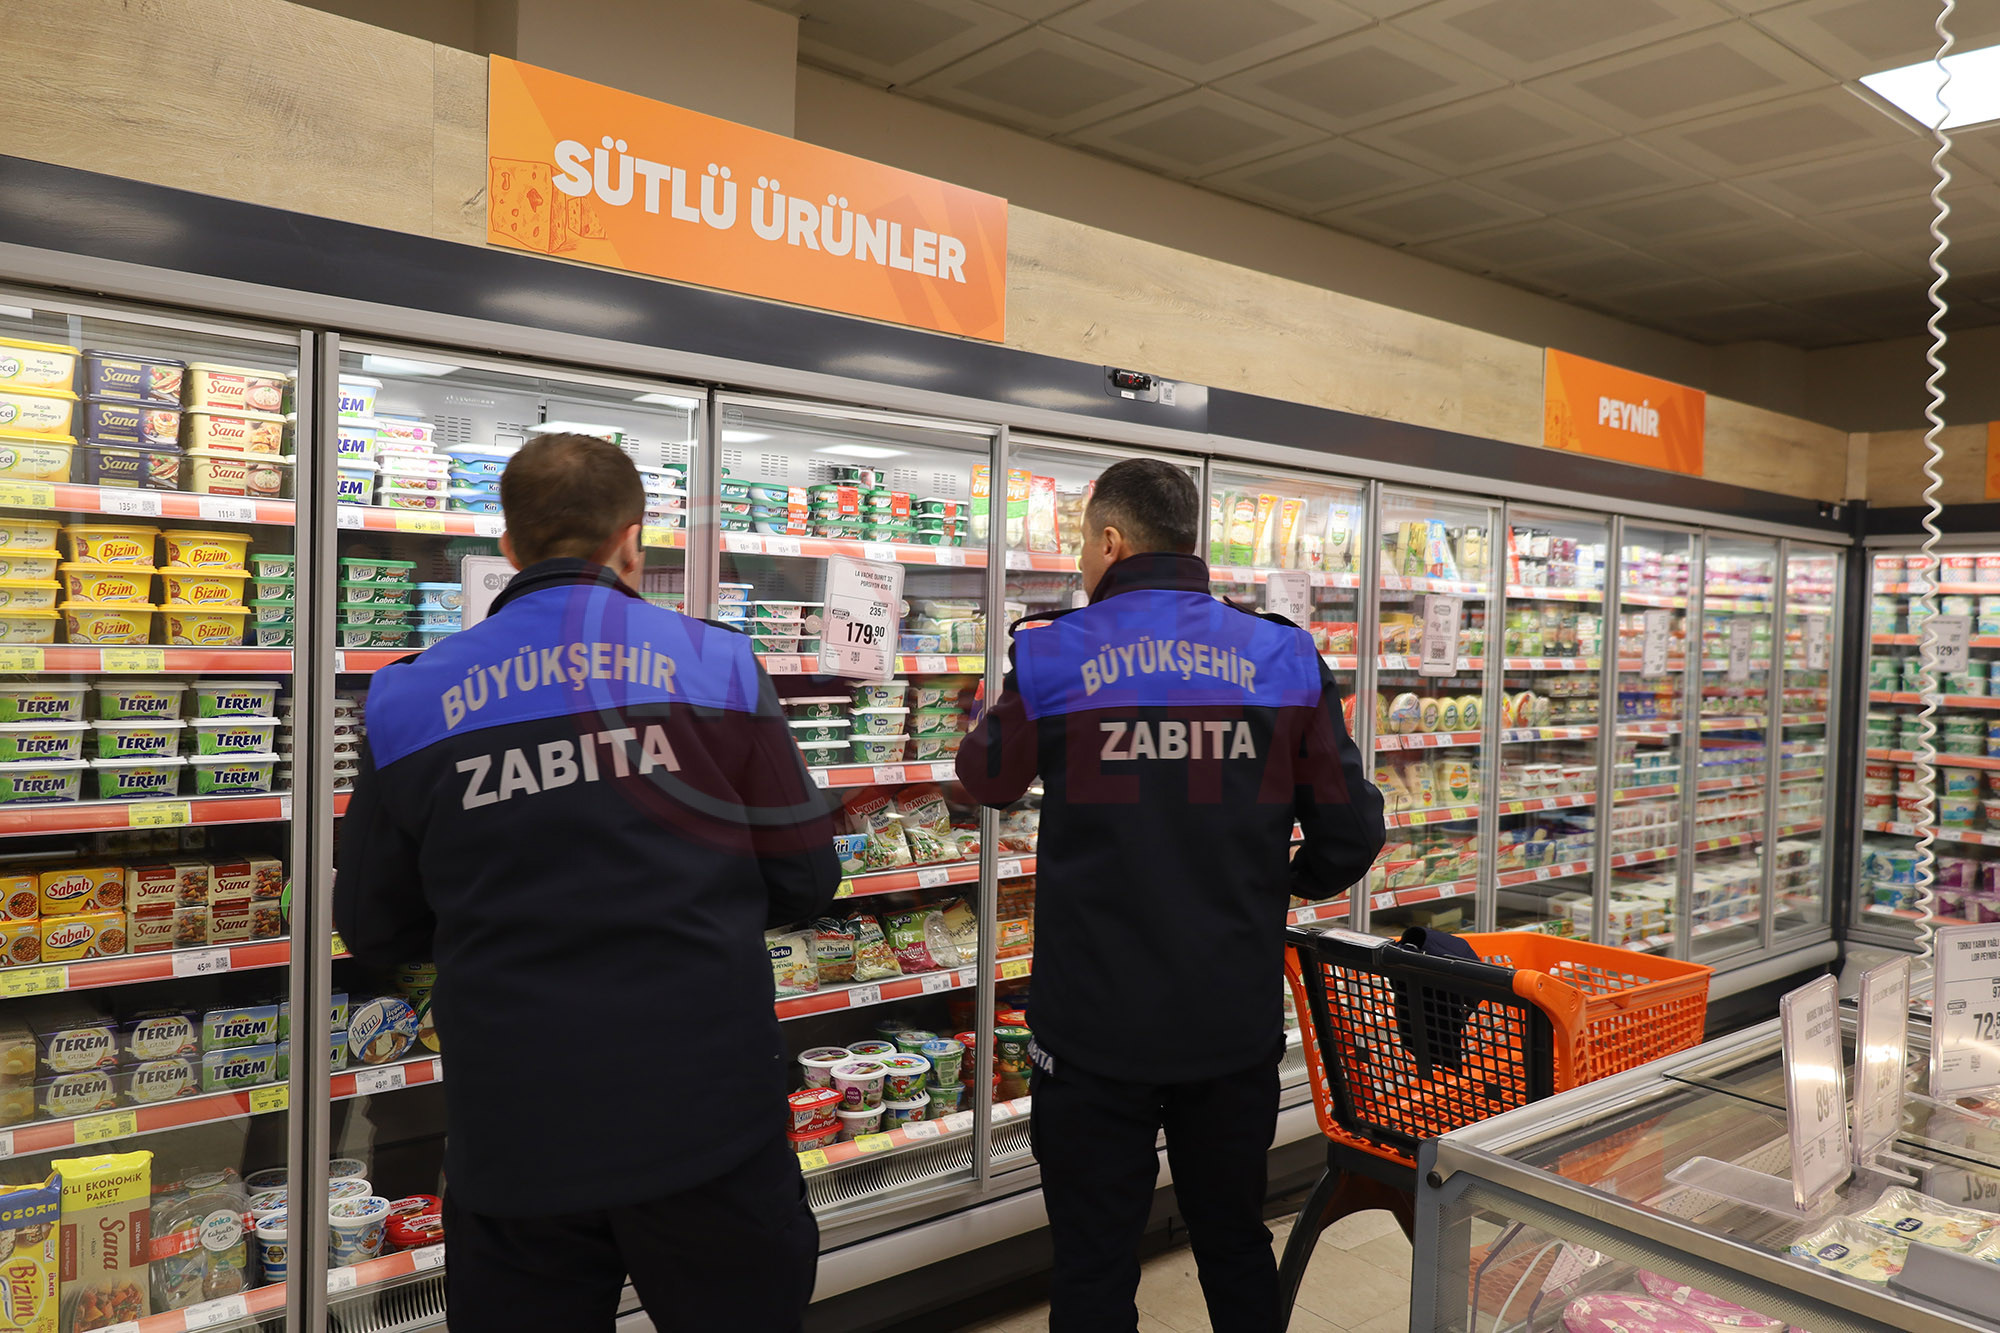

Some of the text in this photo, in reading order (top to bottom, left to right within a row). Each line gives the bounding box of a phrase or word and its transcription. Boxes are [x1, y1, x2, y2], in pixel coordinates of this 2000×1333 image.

[552, 135, 967, 284] SÜTLÜ ÜRÜNLER
[100, 367, 141, 385] Sana
[207, 380, 244, 397] Sana
[98, 410, 139, 428] Sana
[1598, 396, 1660, 438] PEYNİR
[208, 423, 245, 439] Sana
[98, 455, 139, 473] Sana
[208, 464, 246, 480] Sana
[483, 463, 497, 472] Kiri
[484, 502, 498, 512] Kiri
[103, 543, 140, 559] Bizim
[192, 548, 228, 564] Bizim
[96, 582, 135, 597] Bizim
[193, 585, 230, 600] Bizim
[94, 621, 132, 637] Bizim
[197, 623, 233, 639] Bizim
[1080, 636, 1257, 697] BÜYÜKŞEHİR
[440, 641, 677, 731] BÜYÜKŞEHİR
[17, 698, 70, 715] TEREM
[118, 697, 168, 713] TEREM
[215, 695, 262, 711] TEREM
[16, 738, 69, 754] TEREM
[117, 735, 166, 751] TEREM
[216, 733, 262, 748] TEREM
[1099, 720, 1257, 761] ZABITA
[455, 724, 682, 811] ZABITA
[13, 778, 66, 794] TEREM
[118, 774, 167, 789] TEREM
[214, 771, 260, 785] TEREM
[49, 879, 90, 899] Sabah
[137, 882, 176, 898] Sana
[214, 879, 250, 894] Sana
[134, 923, 173, 938] Sana
[212, 918, 249, 934] Sana
[50, 926, 91, 946] Sabah
[769, 948, 791, 957] Torku
[137, 1024, 189, 1041] TEREM
[214, 1020, 267, 1039] TEREM
[55, 1036, 109, 1053] TEREM
[137, 1067, 188, 1085] TEREM
[213, 1060, 266, 1080] TEREM
[53, 1080, 107, 1098] TEREM
[86, 1187, 120, 1202] PAKET
[99, 1216, 126, 1271] Sana
[1820, 1246, 1847, 1260] Torku
[9, 1262, 38, 1321] Bizim
